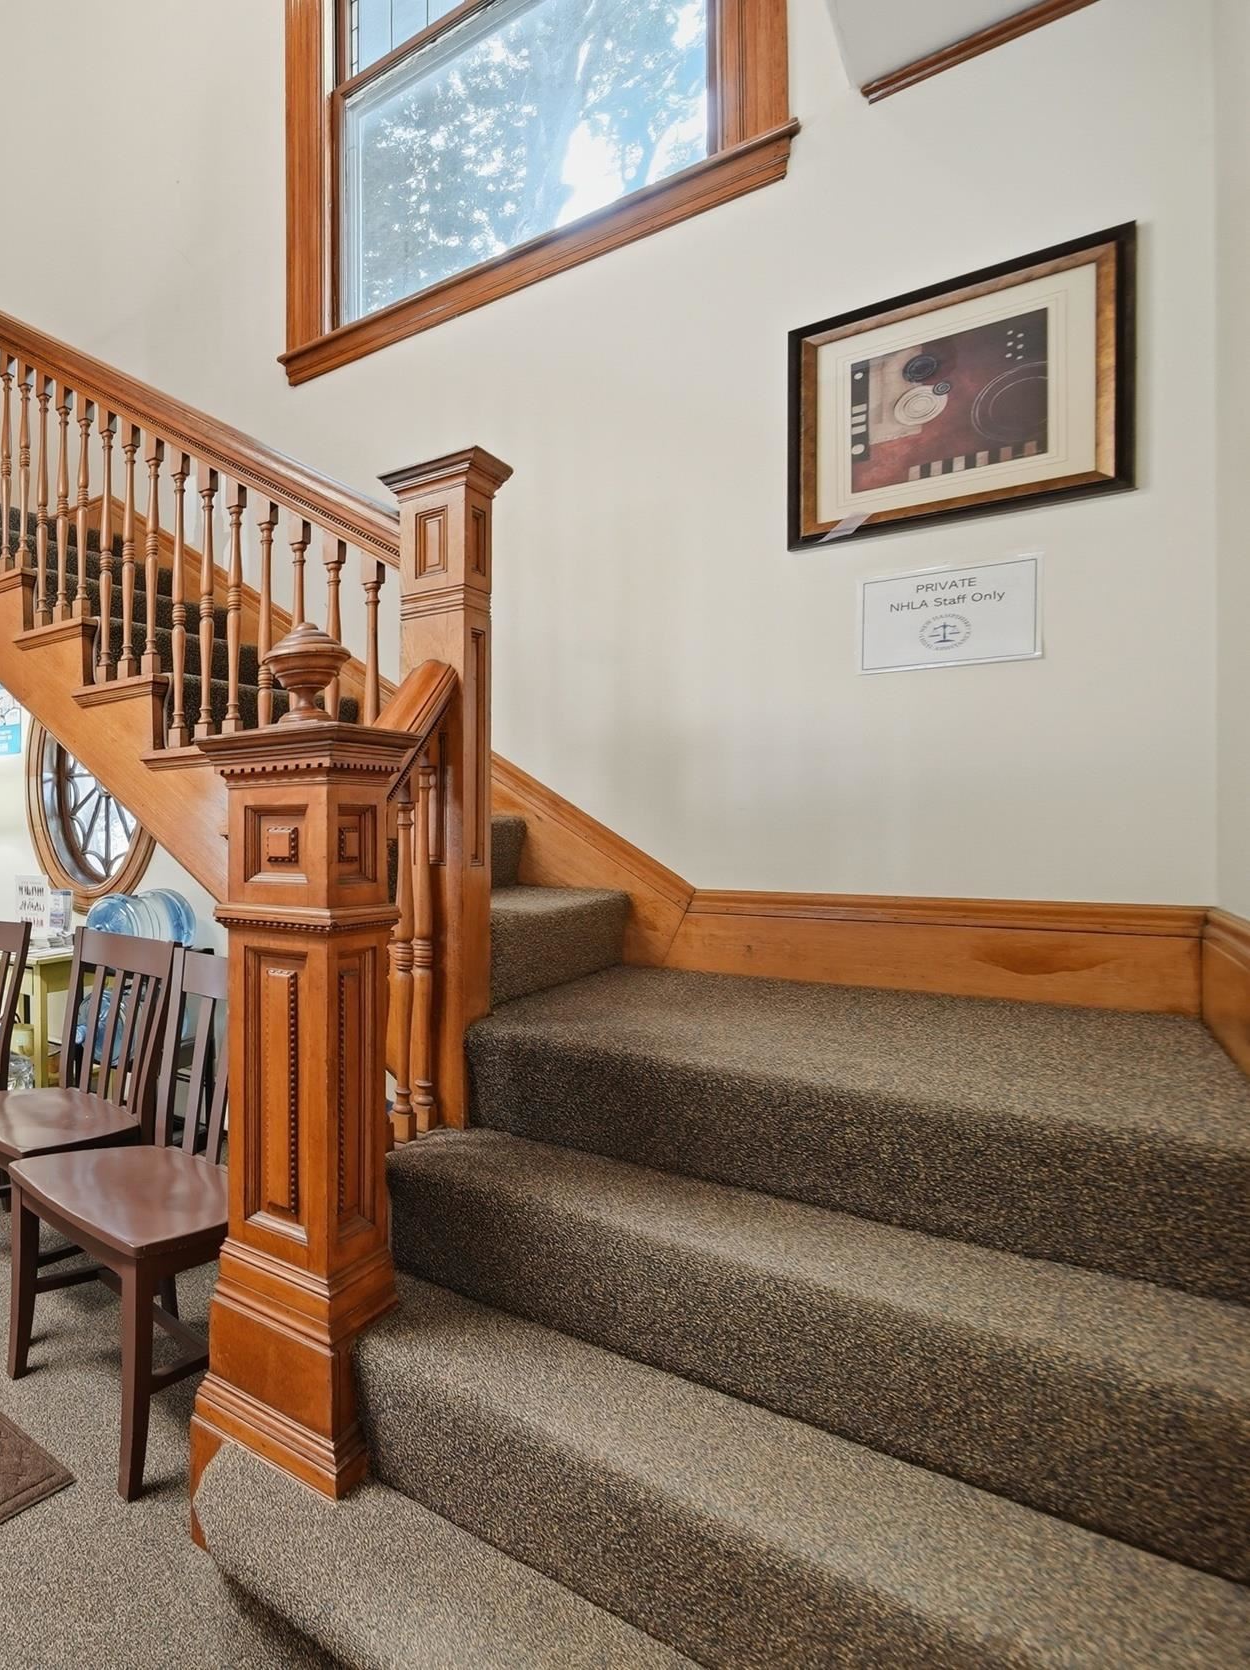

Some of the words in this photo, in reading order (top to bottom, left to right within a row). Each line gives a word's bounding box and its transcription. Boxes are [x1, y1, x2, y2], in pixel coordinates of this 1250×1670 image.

[915, 577, 977, 594] PRIVATE
[889, 599, 929, 613] NHLA
[933, 594, 966, 607] Staff
[971, 591, 1005, 603] Only
